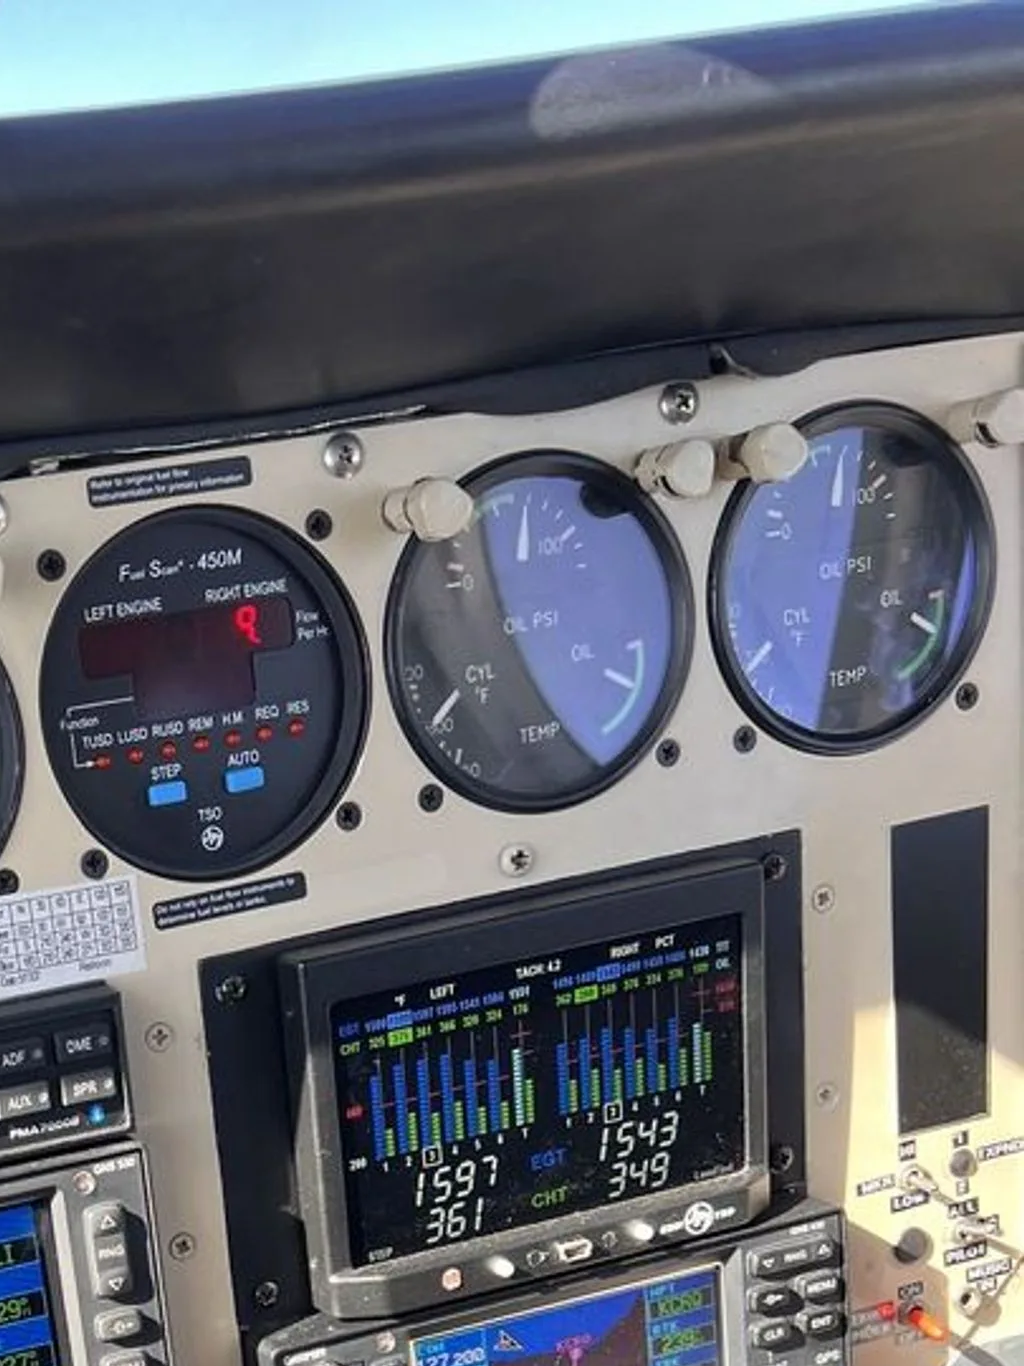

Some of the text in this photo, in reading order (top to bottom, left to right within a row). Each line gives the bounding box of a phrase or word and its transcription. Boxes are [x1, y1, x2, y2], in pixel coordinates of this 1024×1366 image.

[847, 557, 872, 574] PSI
[205, 578, 288, 602] RIGHT ENGINE
[84, 597, 162, 623] LEFT ENGINE
[533, 612, 557, 629] PSI
[466, 664, 495, 684] CYL
[830, 667, 866, 687] TEMP
[188, 700, 309, 731] REM RES
[520, 724, 559, 744] TEMP
[228, 751, 259, 766] AUTO
[151, 764, 181, 780] STEP
[430, 984, 455, 1000] LEFT
[2, 1052, 25, 1067] ADF
[599, 1111, 679, 1161] 1543
[531, 1148, 567, 1169] EGT
[416, 1155, 498, 1207] 1597
[609, 1152, 670, 1198] 349
[531, 1188, 568, 1207] CHT
[427, 1198, 484, 1243] 361
